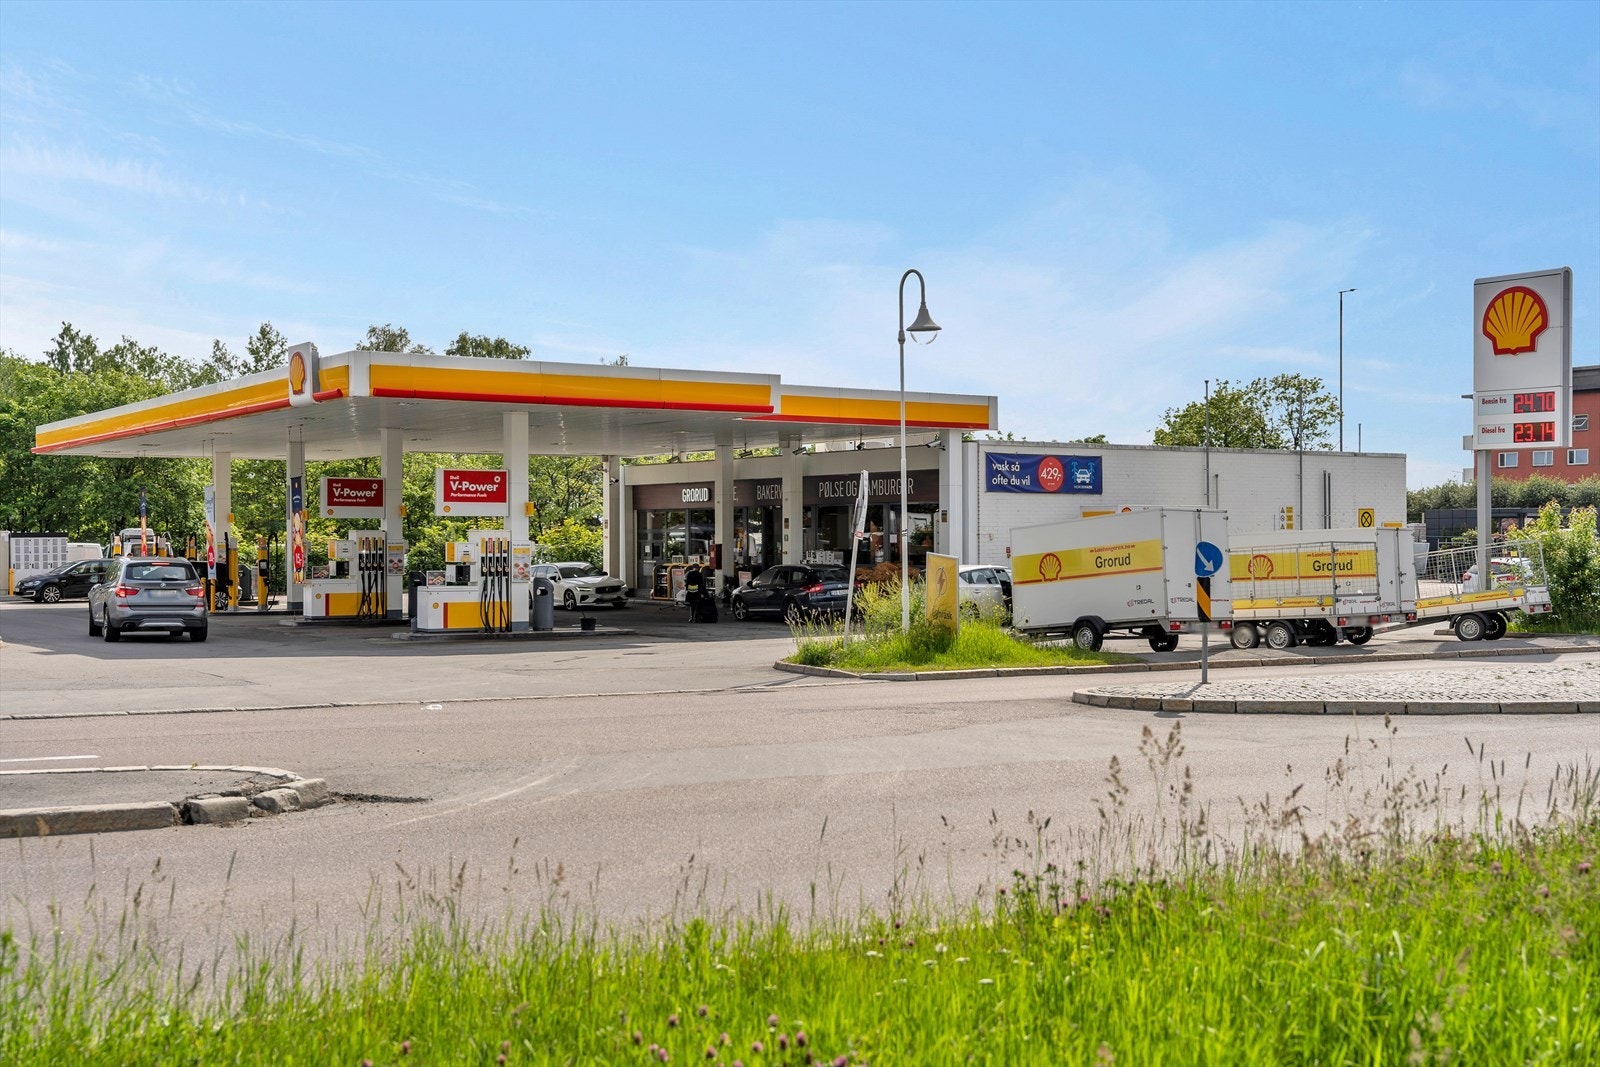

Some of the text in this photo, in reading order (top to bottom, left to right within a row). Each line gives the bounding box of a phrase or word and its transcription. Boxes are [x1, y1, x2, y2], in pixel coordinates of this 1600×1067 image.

[1514, 393, 1555, 413] 24.70
[1514, 423, 1555, 442] 23.14
[992, 460, 1020, 472] vask så
[992, 474, 1031, 486] ofte du vil
[1041, 467, 1062, 481] 429,-
[333, 487, 377, 498] V-Power
[450, 481, 499, 492] V-Power
[819, 478, 914, 498] PØLSE OG MBURGR
[682, 488, 709, 502] GRORUD
[1095, 553, 1131, 569] Grorud
